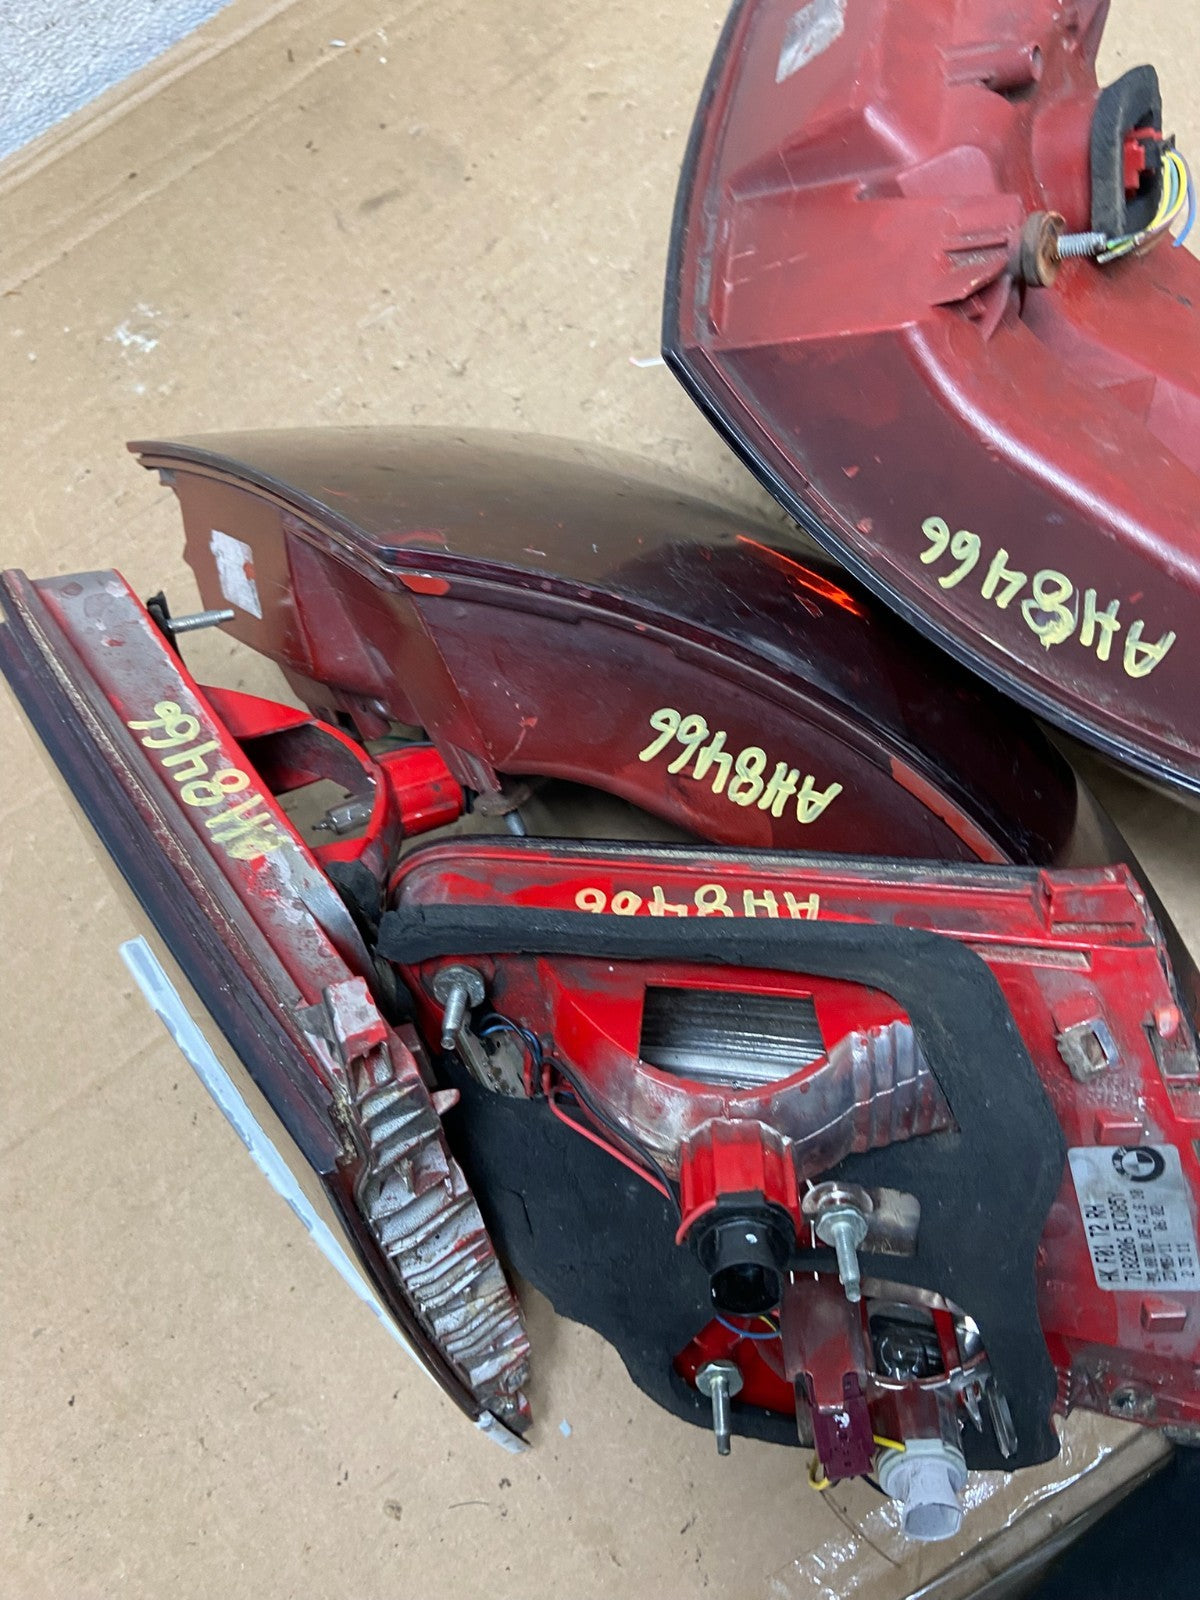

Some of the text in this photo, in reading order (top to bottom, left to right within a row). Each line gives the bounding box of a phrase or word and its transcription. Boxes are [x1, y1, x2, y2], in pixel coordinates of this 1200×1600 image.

[919, 517, 1175, 680] AH8466
[638, 707, 843, 824] AH8466
[1083, 1204, 1106, 1219] RH
[1088, 1223, 1111, 1237] T2
[1092, 1245, 1116, 1264] F01
